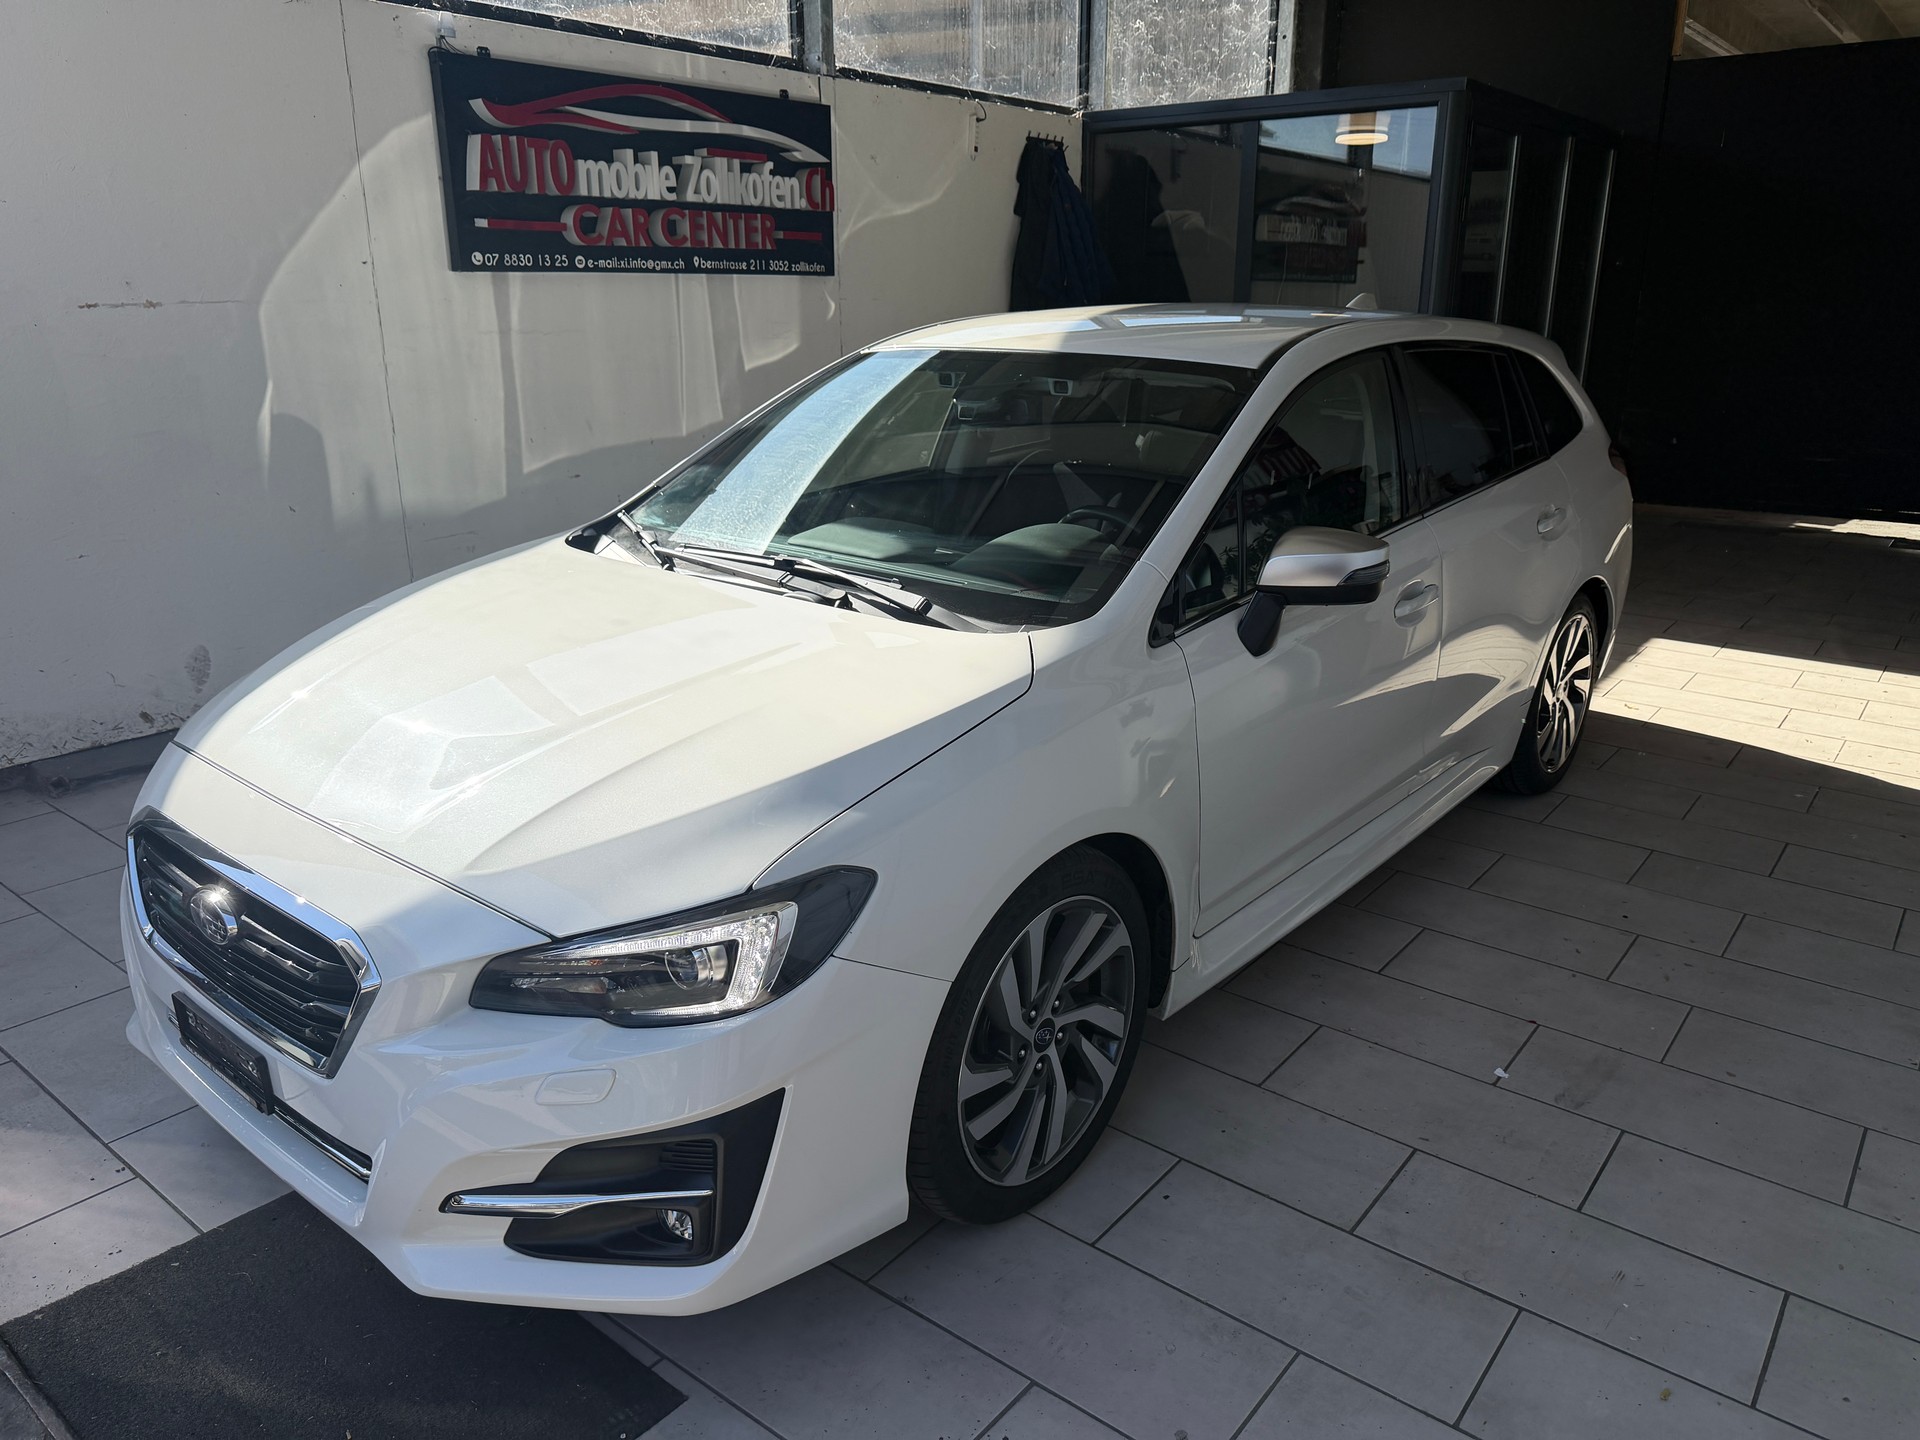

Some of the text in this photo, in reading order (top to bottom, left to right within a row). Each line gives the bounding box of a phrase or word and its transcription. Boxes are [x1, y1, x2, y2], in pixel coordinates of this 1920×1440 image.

[566, 204, 777, 250] CAR CENTER
[484, 253, 569, 267] 07 8830 13 25
[700, 257, 826, 273] bernstrasse 211 3052 zollikofen
